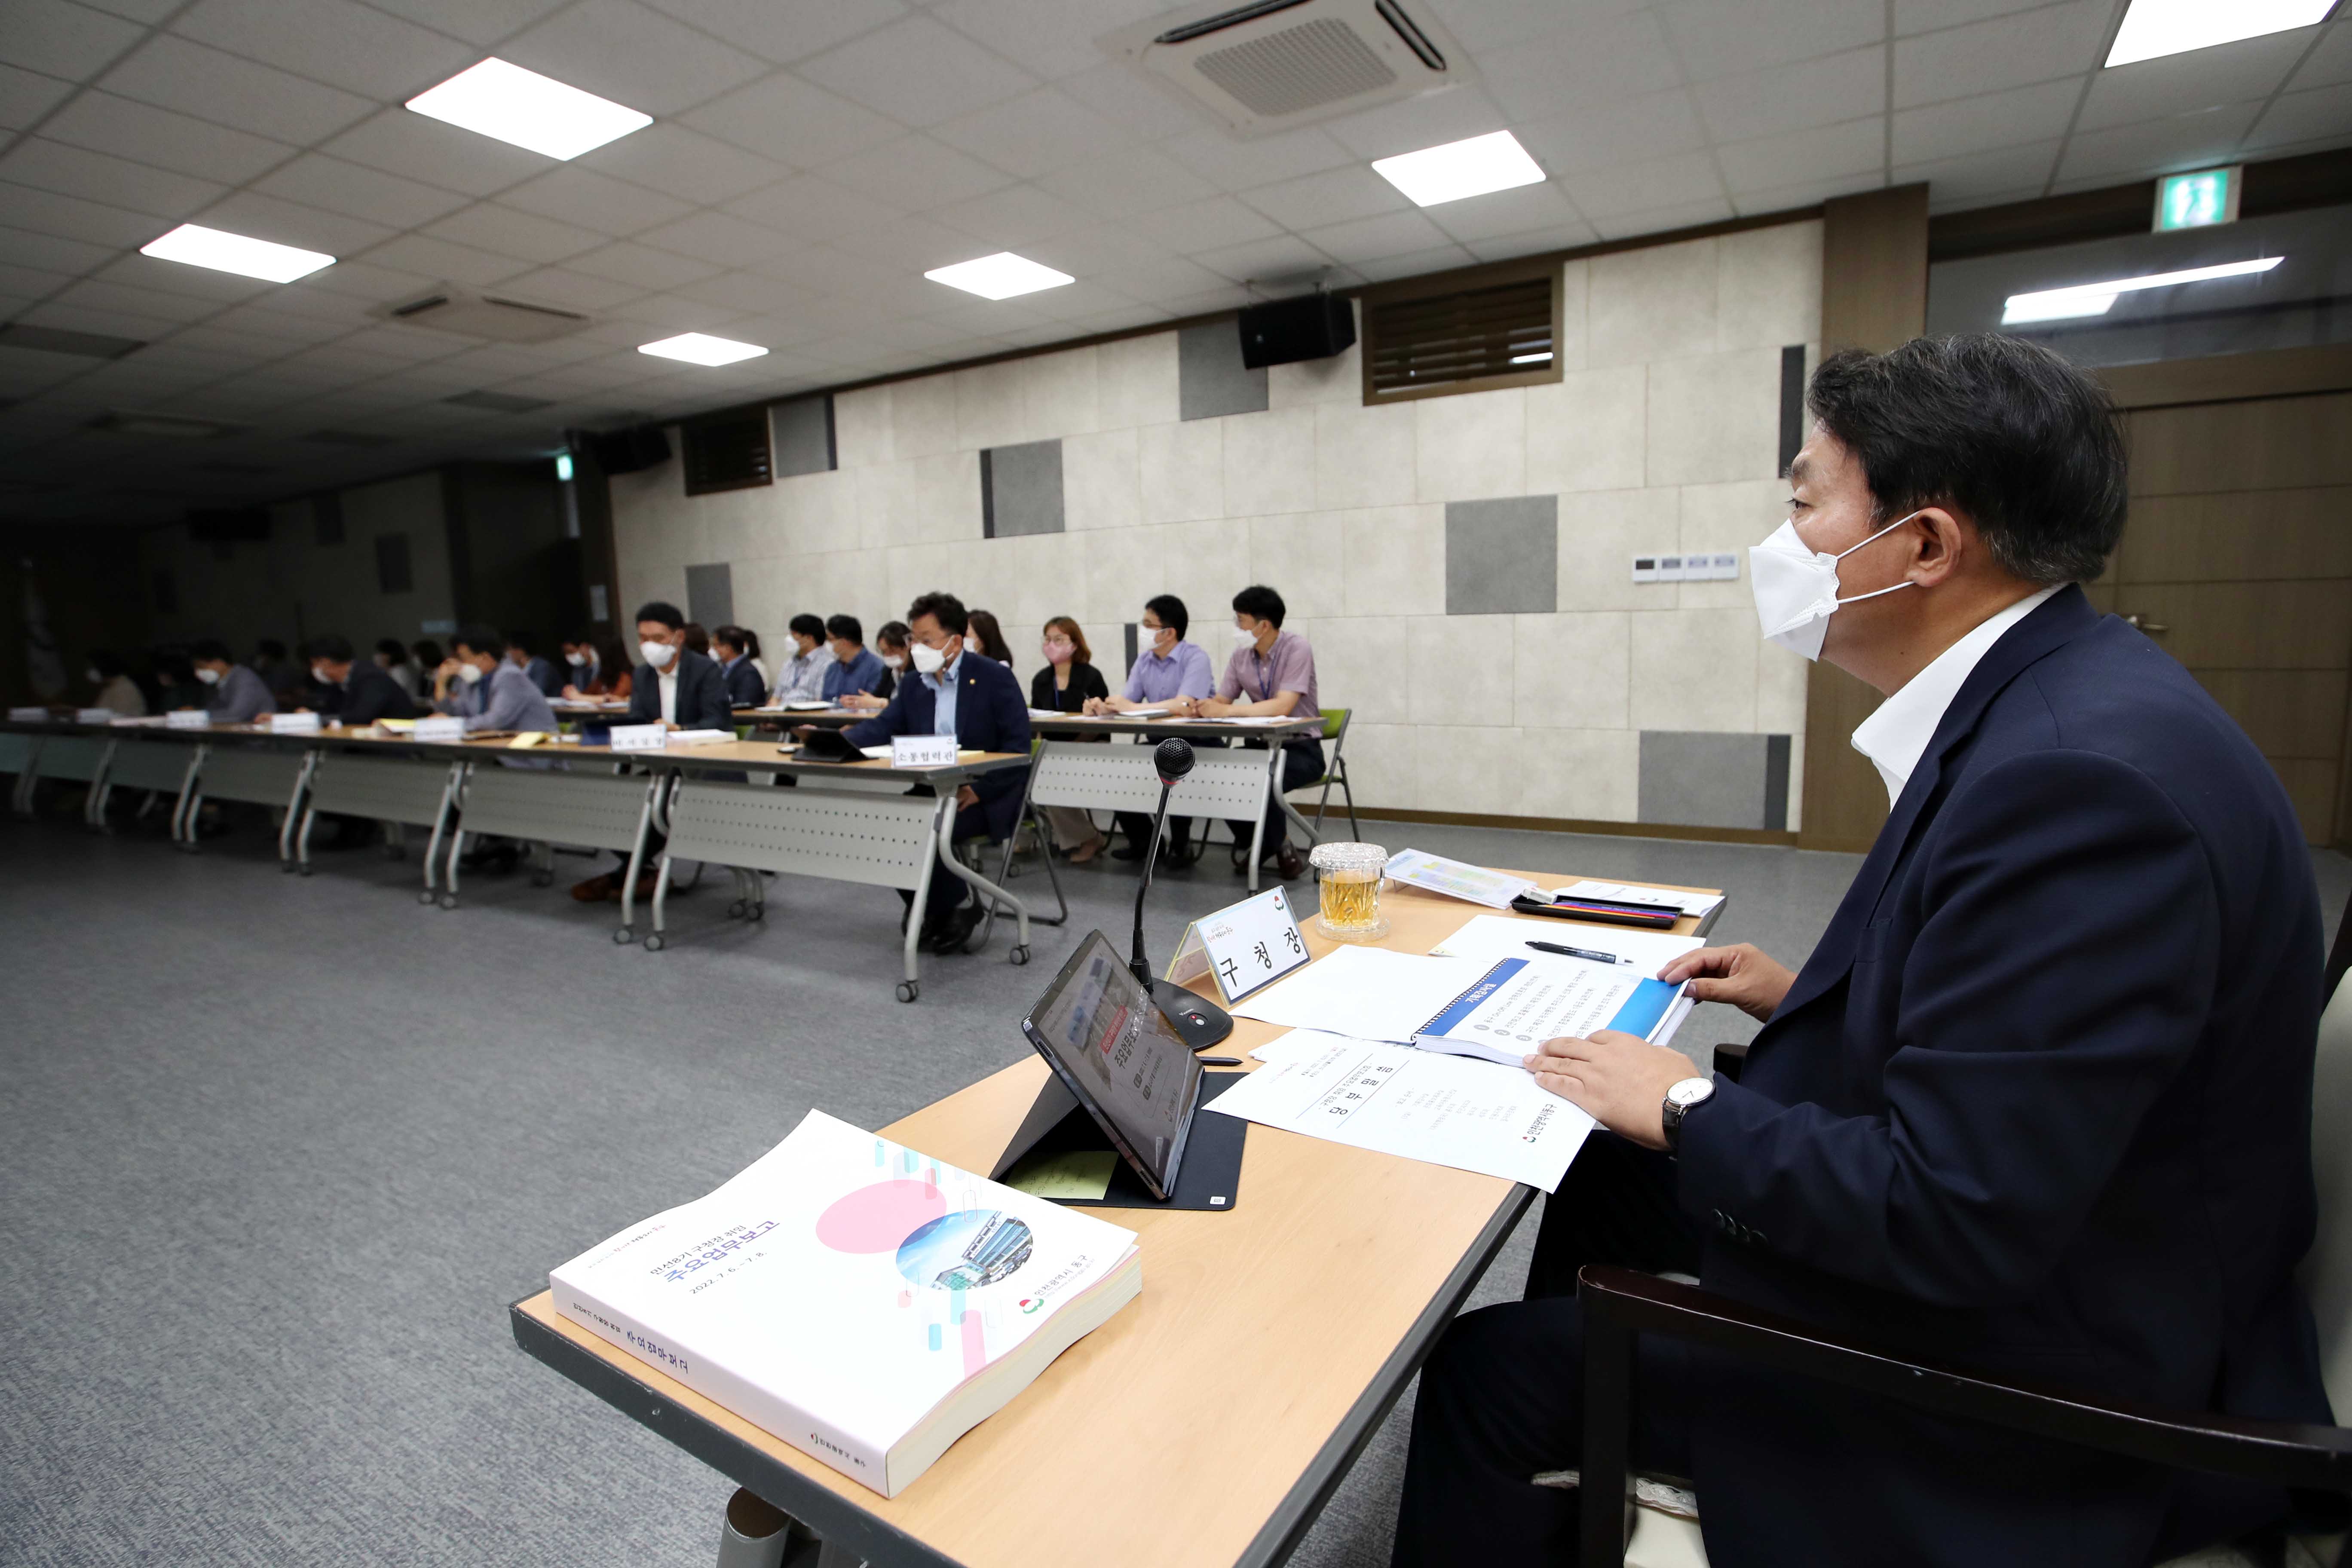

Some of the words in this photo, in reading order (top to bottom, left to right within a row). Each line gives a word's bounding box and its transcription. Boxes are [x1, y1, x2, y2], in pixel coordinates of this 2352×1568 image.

[1464, 983, 1497, 1004] 기획감사실
[1320, 1095, 1337, 1106] 구청장
[1333, 1087, 1346, 1096] 취임
[649, 1251, 692, 1276] 민선8기
[691, 1236, 724, 1253] 구청장
[723, 1225, 747, 1237] 취임
[664, 1220, 781, 1283] 주요업무보고
[1034, 1268, 1073, 1296] 인천광역시
[1071, 1254, 1087, 1268] 동구
[627, 1330, 688, 1374] 주요업무보고
